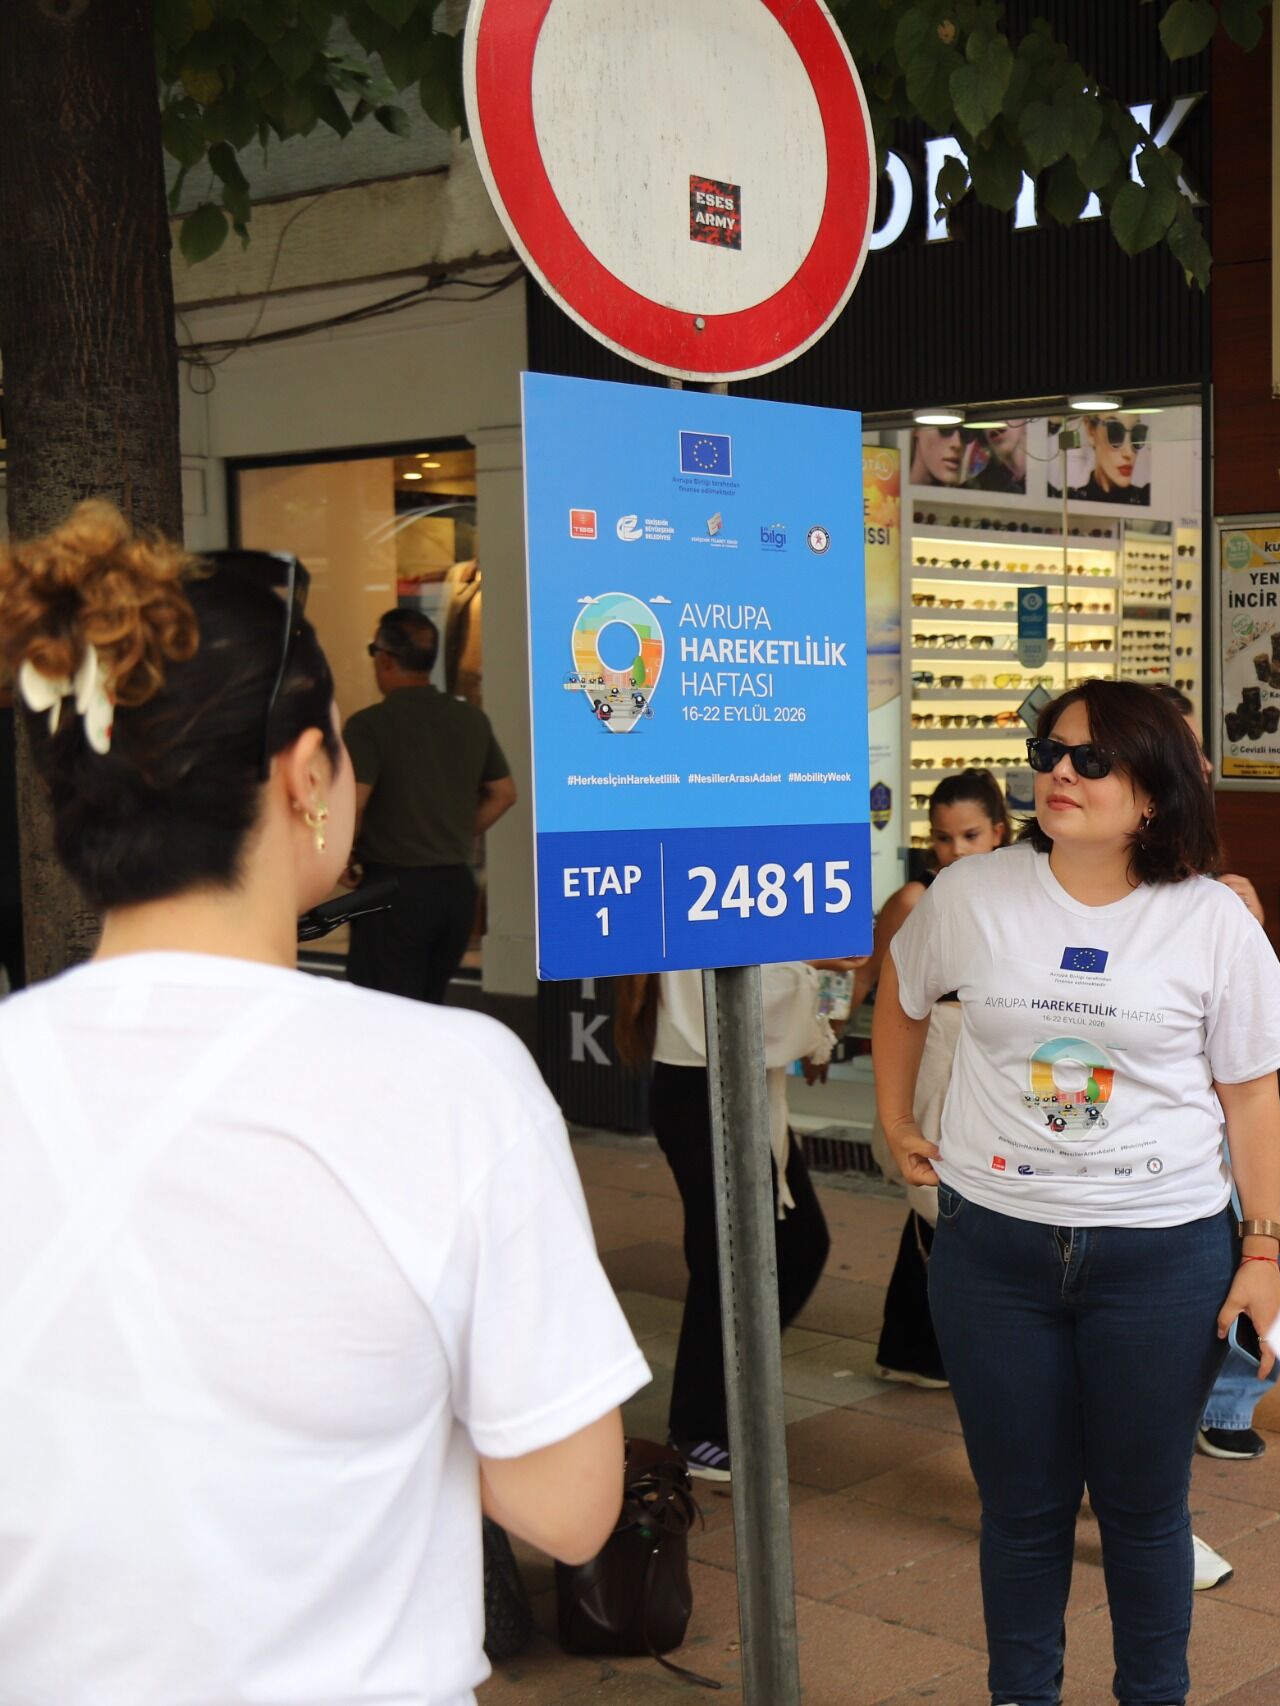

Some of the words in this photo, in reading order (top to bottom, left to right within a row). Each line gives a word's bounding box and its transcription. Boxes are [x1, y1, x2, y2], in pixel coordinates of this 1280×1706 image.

[696, 191, 735, 211] ESES
[695, 211, 736, 230] ARMY
[1228, 589, 1278, 609] İNCİR
[679, 602, 772, 631] AVRUPA
[680, 635, 848, 667] HAREKETLİLİK
[681, 671, 774, 698] HAFTASI
[682, 705, 721, 722] 16-22
[724, 703, 772, 722] EYLÜL
[774, 706, 807, 722] 2026
[788, 772, 852, 785] #MobilityWeek
[563, 865, 642, 898] ETAP
[688, 860, 852, 922] 24815
[595, 906, 609, 937] 1
[984, 996, 1028, 1009] AVRUPA
[1031, 998, 1117, 1018] HAREKETLİLİK
[1120, 1009, 1165, 1024] HAFTASI
[1043, 1014, 1062, 1023] 16-22
[1063, 1016, 1087, 1026] EYLÜL
[1088, 1019, 1105, 1028] 2026
